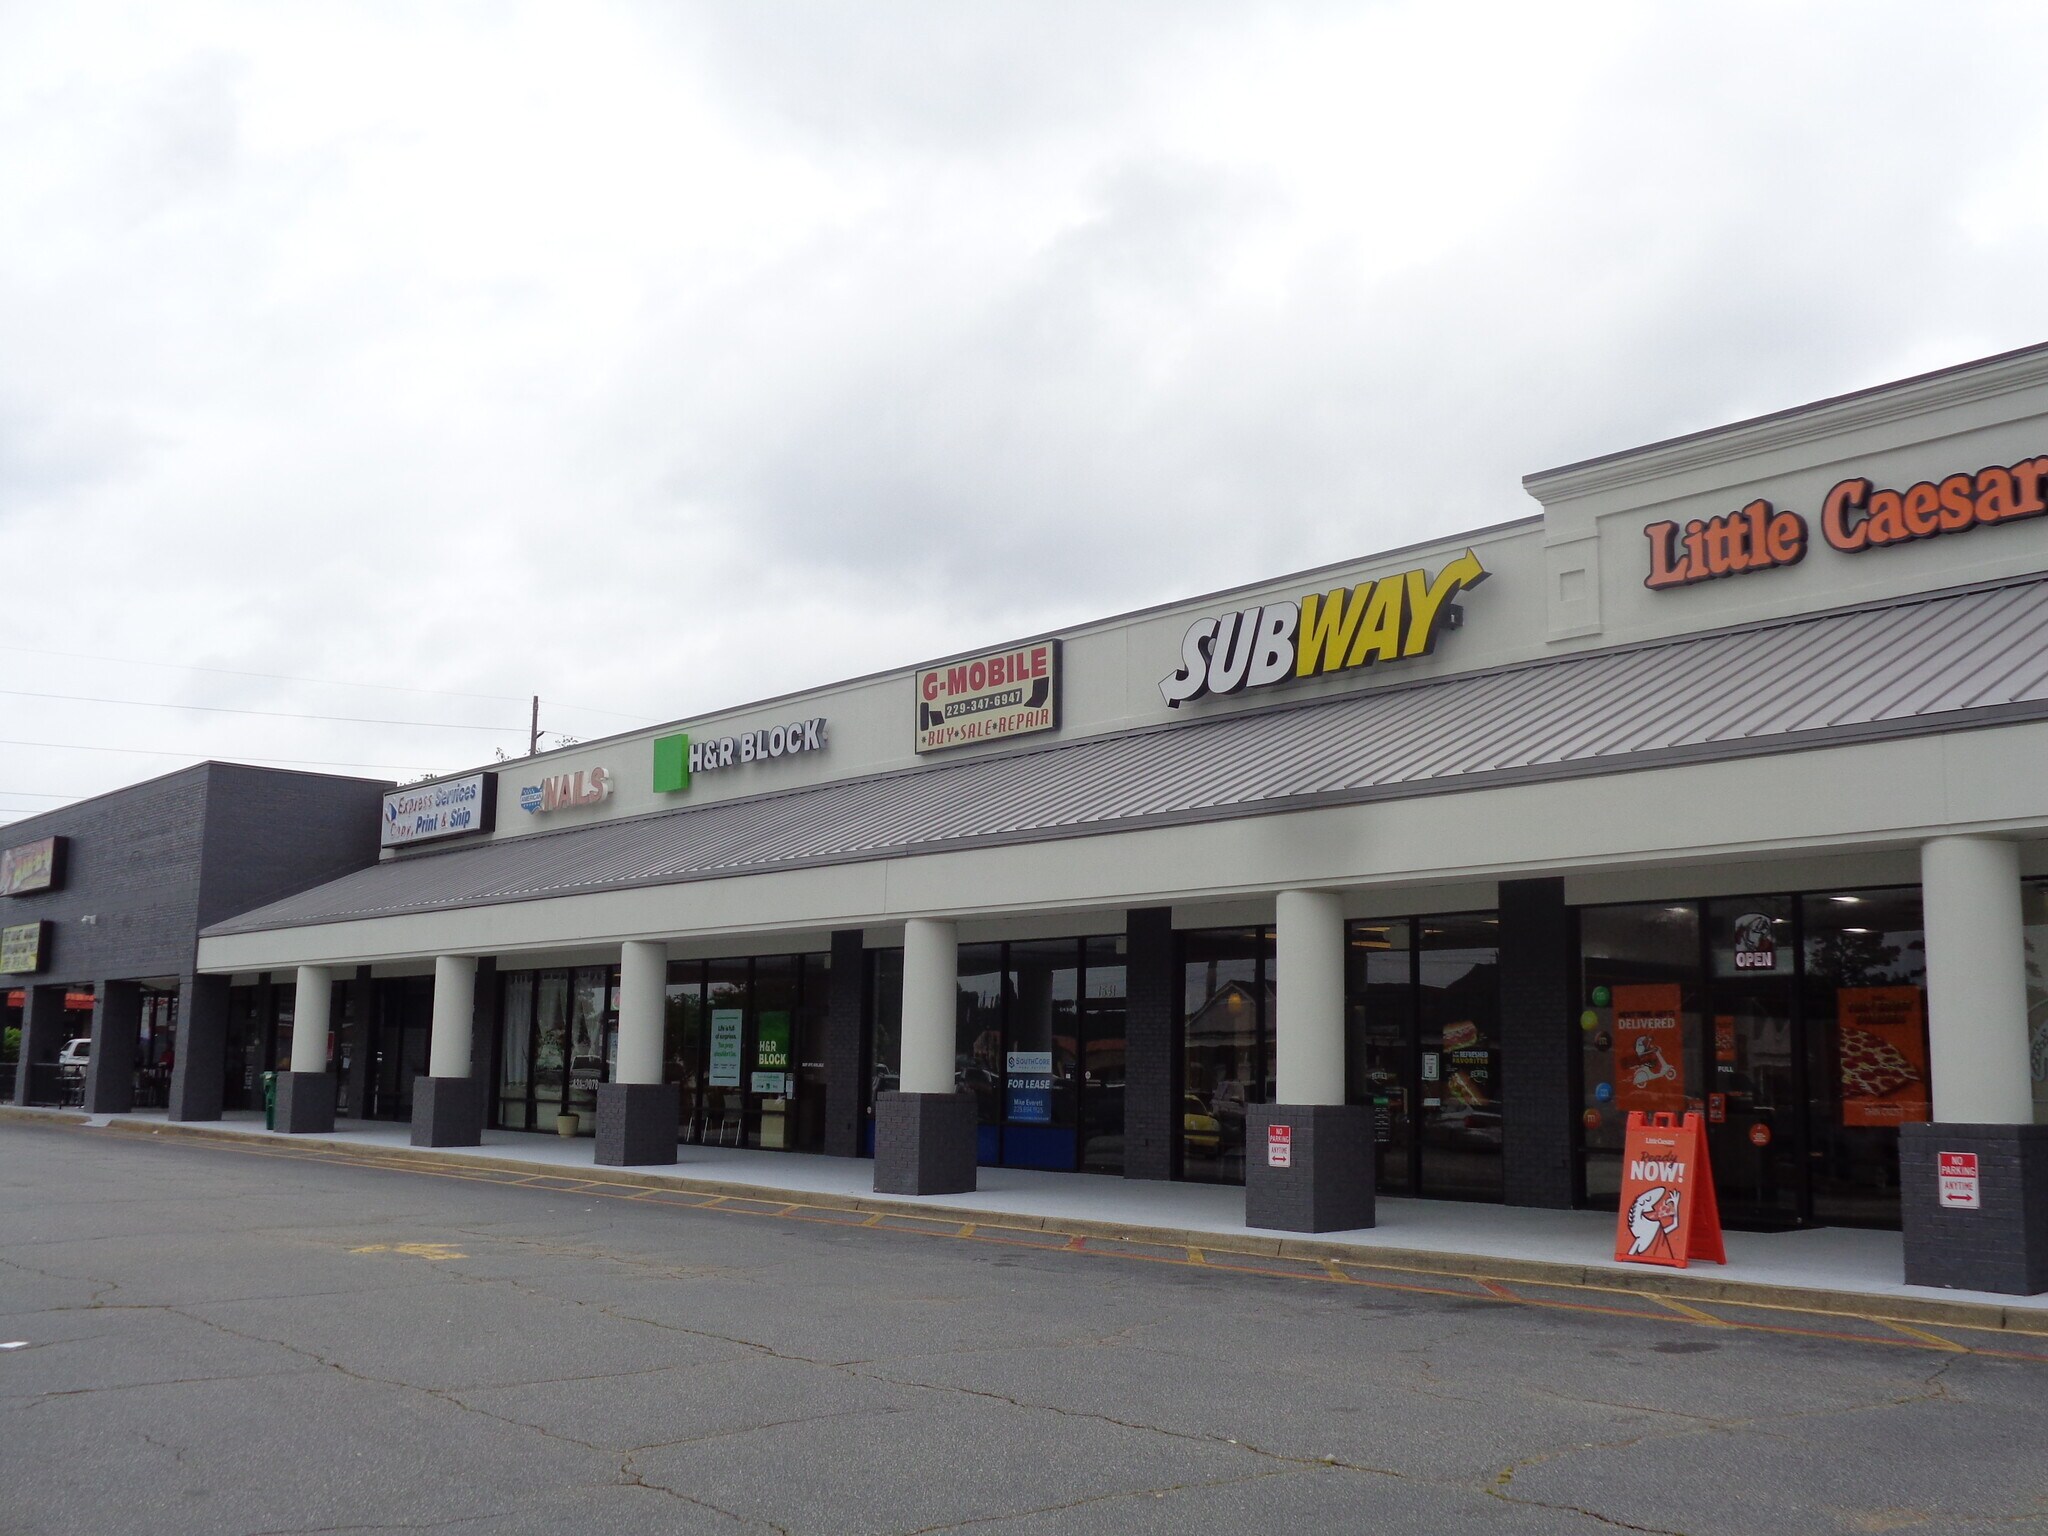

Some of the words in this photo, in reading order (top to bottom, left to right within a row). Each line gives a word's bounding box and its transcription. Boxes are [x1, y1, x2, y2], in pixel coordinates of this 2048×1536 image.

[1643, 497, 1808, 592] Little
[1158, 547, 1484, 707] SUBWAY
[922, 646, 1047, 702] G-MOBILE
[945, 690, 1022, 717] 229-347-6947
[928, 726, 956, 746] BUY
[957, 719, 993, 741] SALE
[998, 708, 1049, 733] REPAIR
[689, 737, 736, 773] H&R
[741, 718, 824, 763] BLOCK
[543, 766, 608, 812] NAILS
[398, 795, 433, 815] Express
[435, 783, 477, 807] Services
[416, 813, 439, 834] Print
[449, 806, 471, 828] Ship
[1736, 951, 1772, 967] OPEN
[1618, 1017, 1676, 1030] DELIVERED
[759, 1040, 777, 1052] H&R
[758, 1053, 787, 1065] BLOCK
[1717, 1065, 1734, 1073] PULL
[1007, 1079, 1024, 1089] FOR
[1025, 1079, 1050, 1089] LEASE
[1269, 1135, 1290, 1143] PARKING
[1641, 1150, 1679, 1169] Ready
[1951, 1156, 1964, 1166] NO
[1630, 1160, 1686, 1183] NOW!
[1941, 1166, 1977, 1177] PARKING
[1945, 1181, 1974, 1191] ANYTIME
